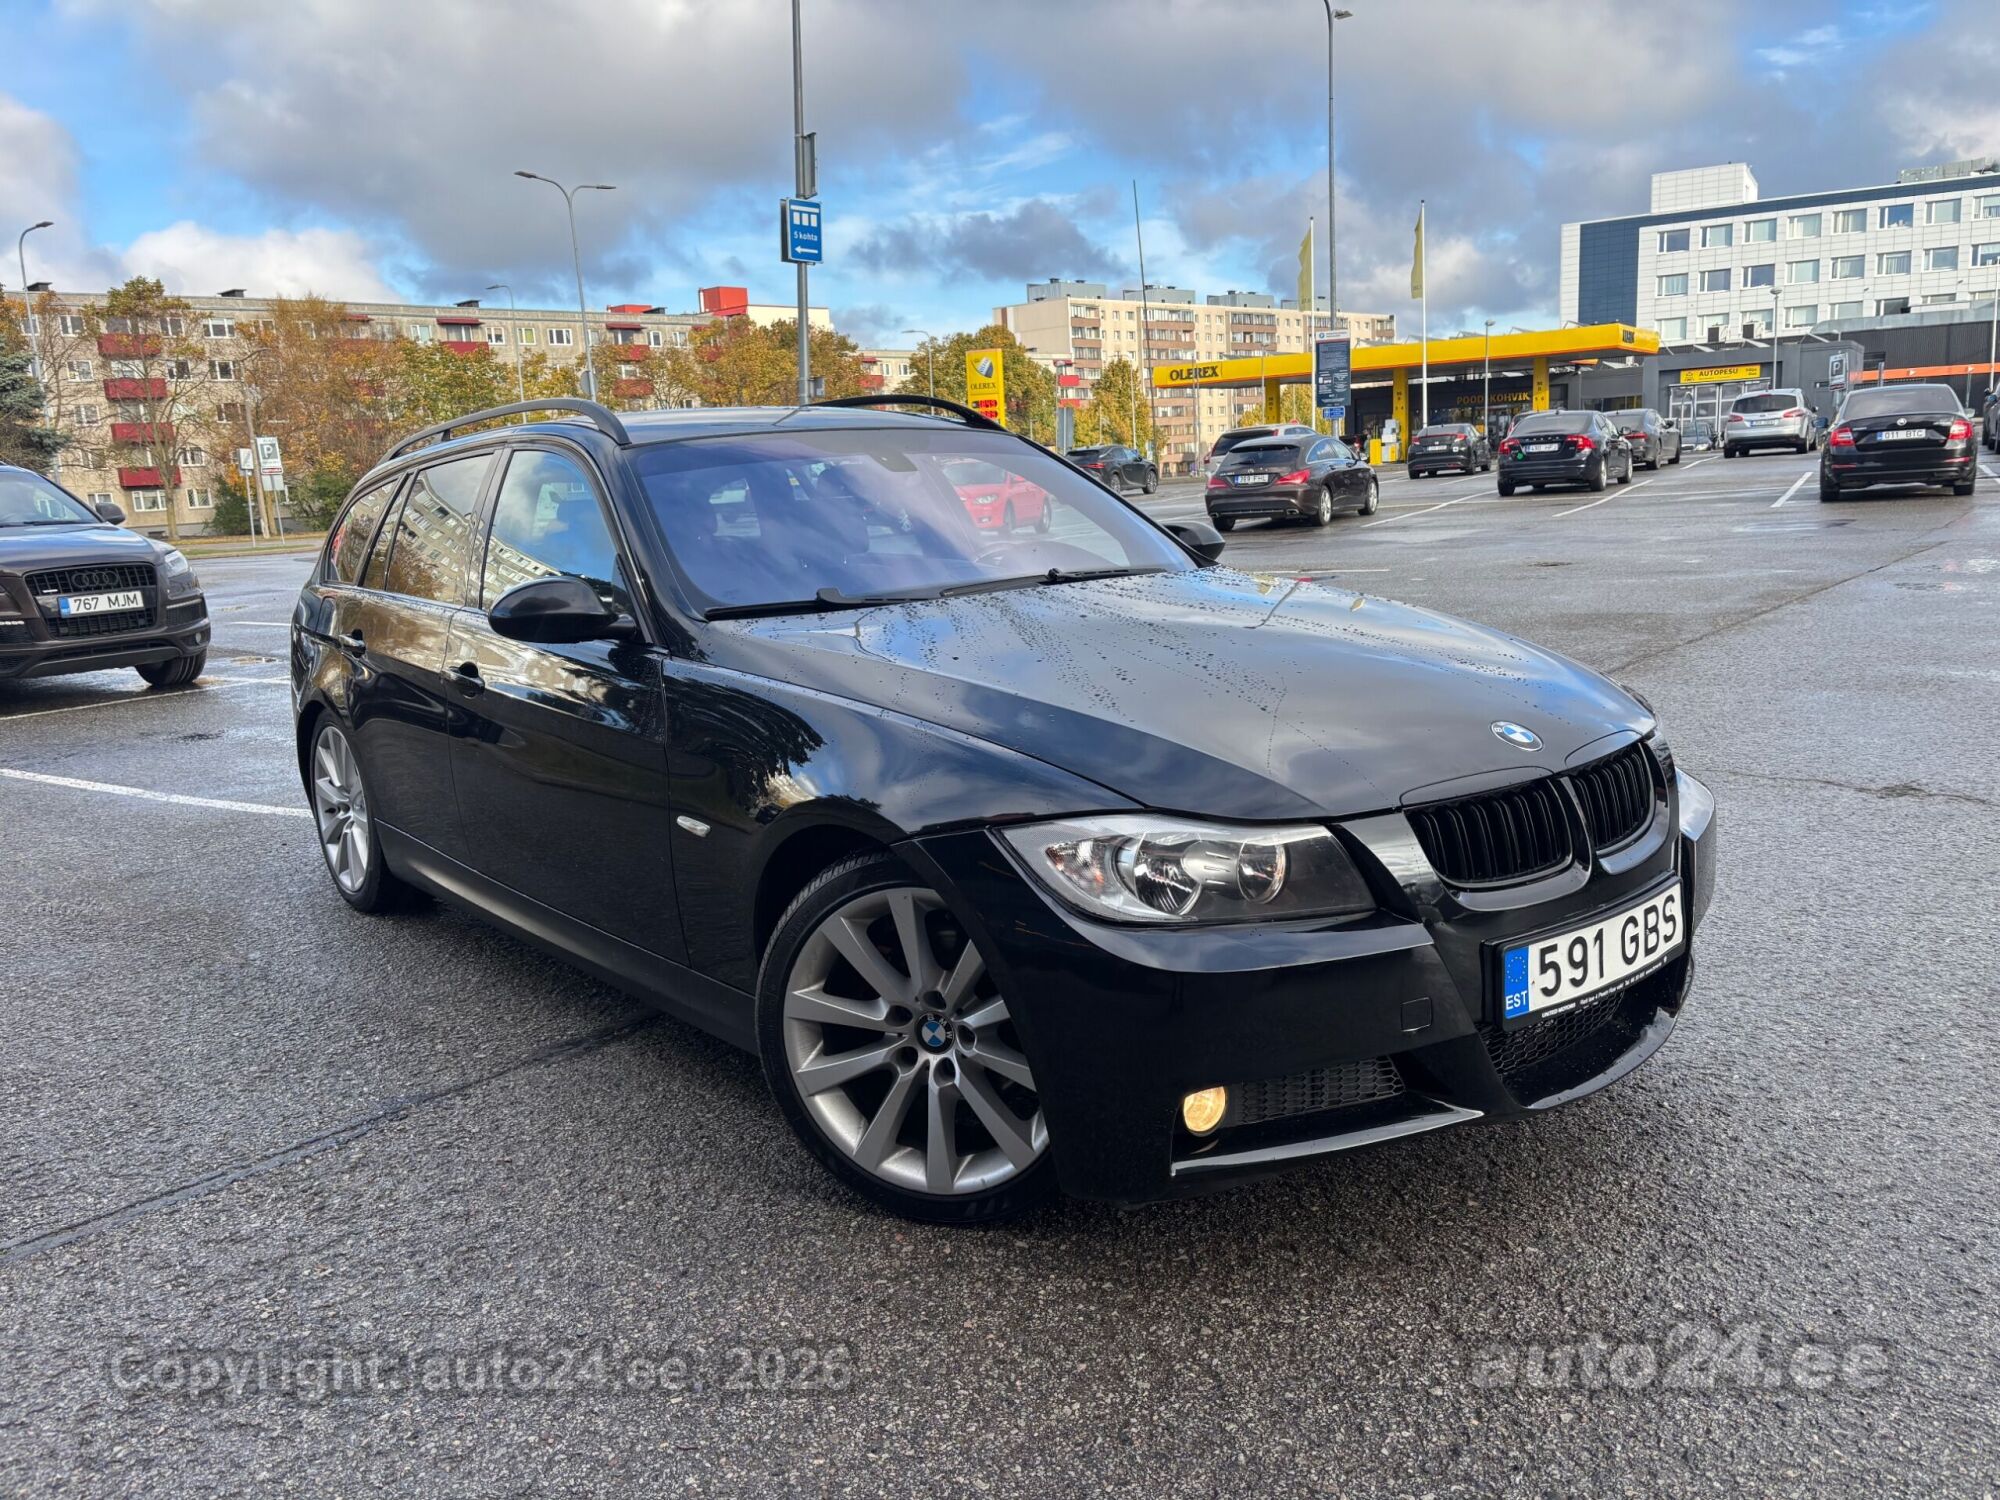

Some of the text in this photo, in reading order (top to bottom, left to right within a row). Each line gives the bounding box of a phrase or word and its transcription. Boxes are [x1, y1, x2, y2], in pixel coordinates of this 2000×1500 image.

[793, 230, 818, 241] 5 kohta
[1169, 365, 1219, 381] OLEREX
[1698, 367, 1739, 377] AUTOPESU
[970, 382, 996, 390] OLEREX
[1456, 391, 1530, 405] POOD KOHVIK
[263, 444, 273, 458] P
[74, 593, 139, 612] 767 MJM
[1539, 894, 1677, 998] 591 GBS
[1505, 990, 1528, 1010] EST
